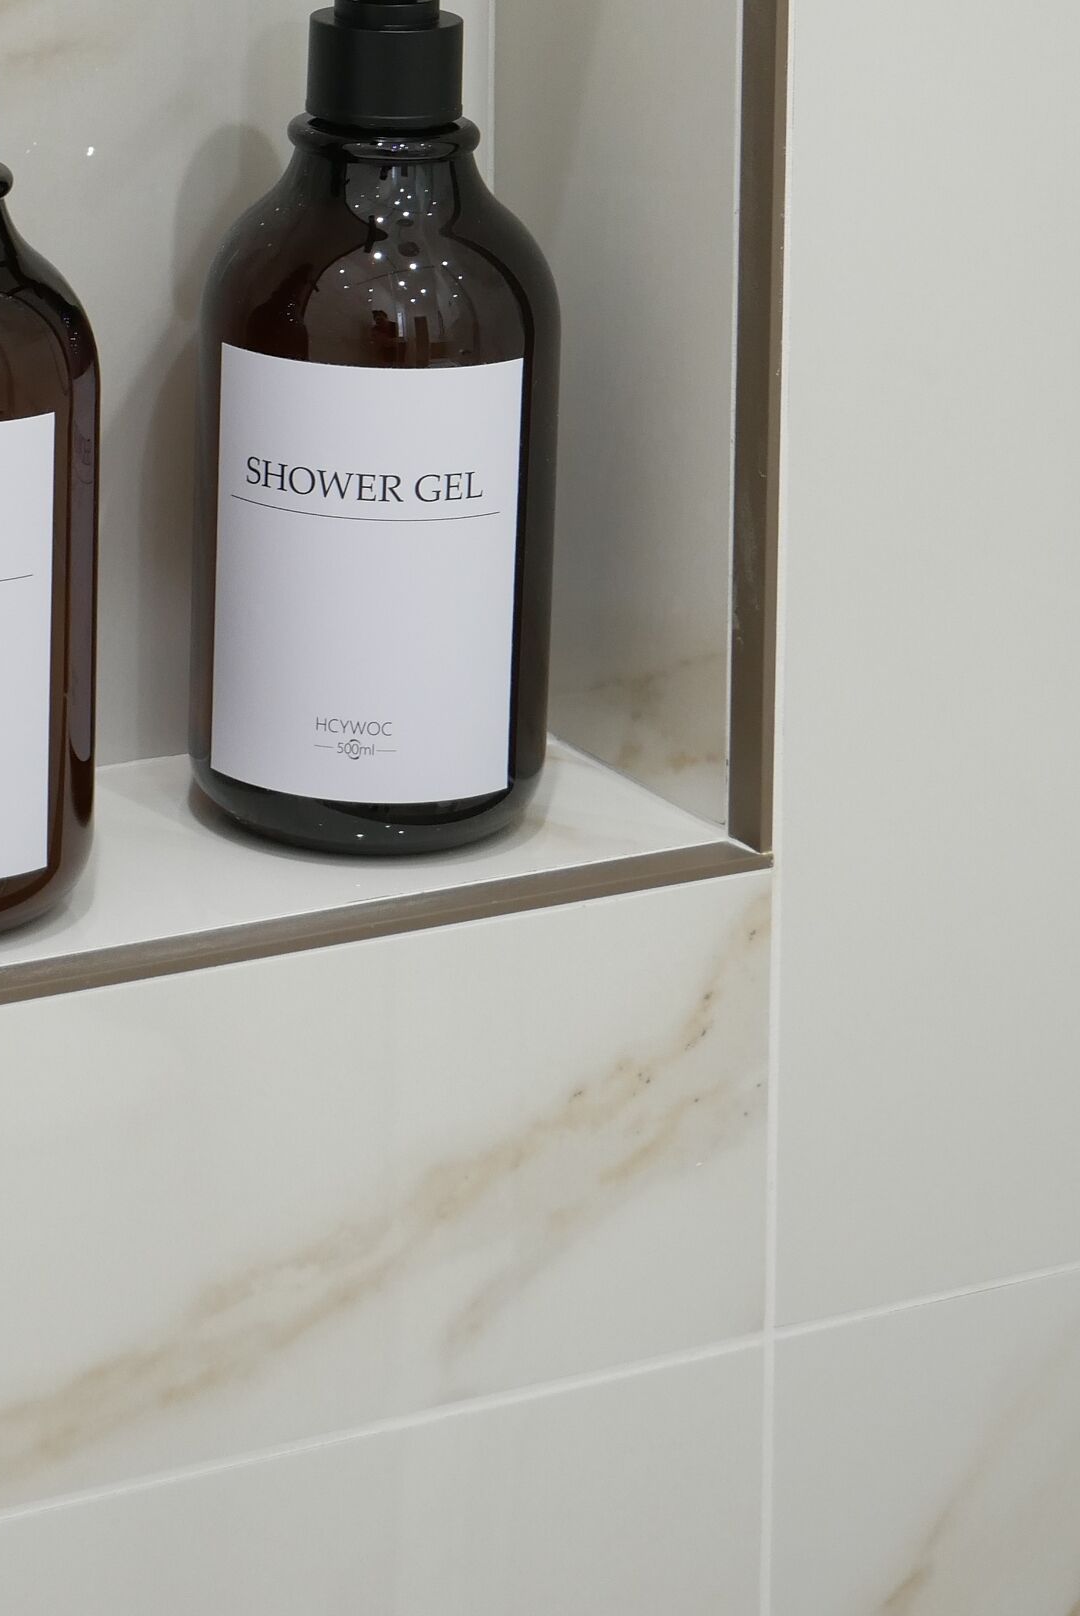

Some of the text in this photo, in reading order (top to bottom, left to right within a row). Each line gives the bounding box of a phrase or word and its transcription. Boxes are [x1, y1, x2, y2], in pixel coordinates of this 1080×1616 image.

[245, 456, 484, 503] SHOWER GEL
[315, 716, 393, 736] HCYWOC
[336, 742, 375, 756] 500ml
